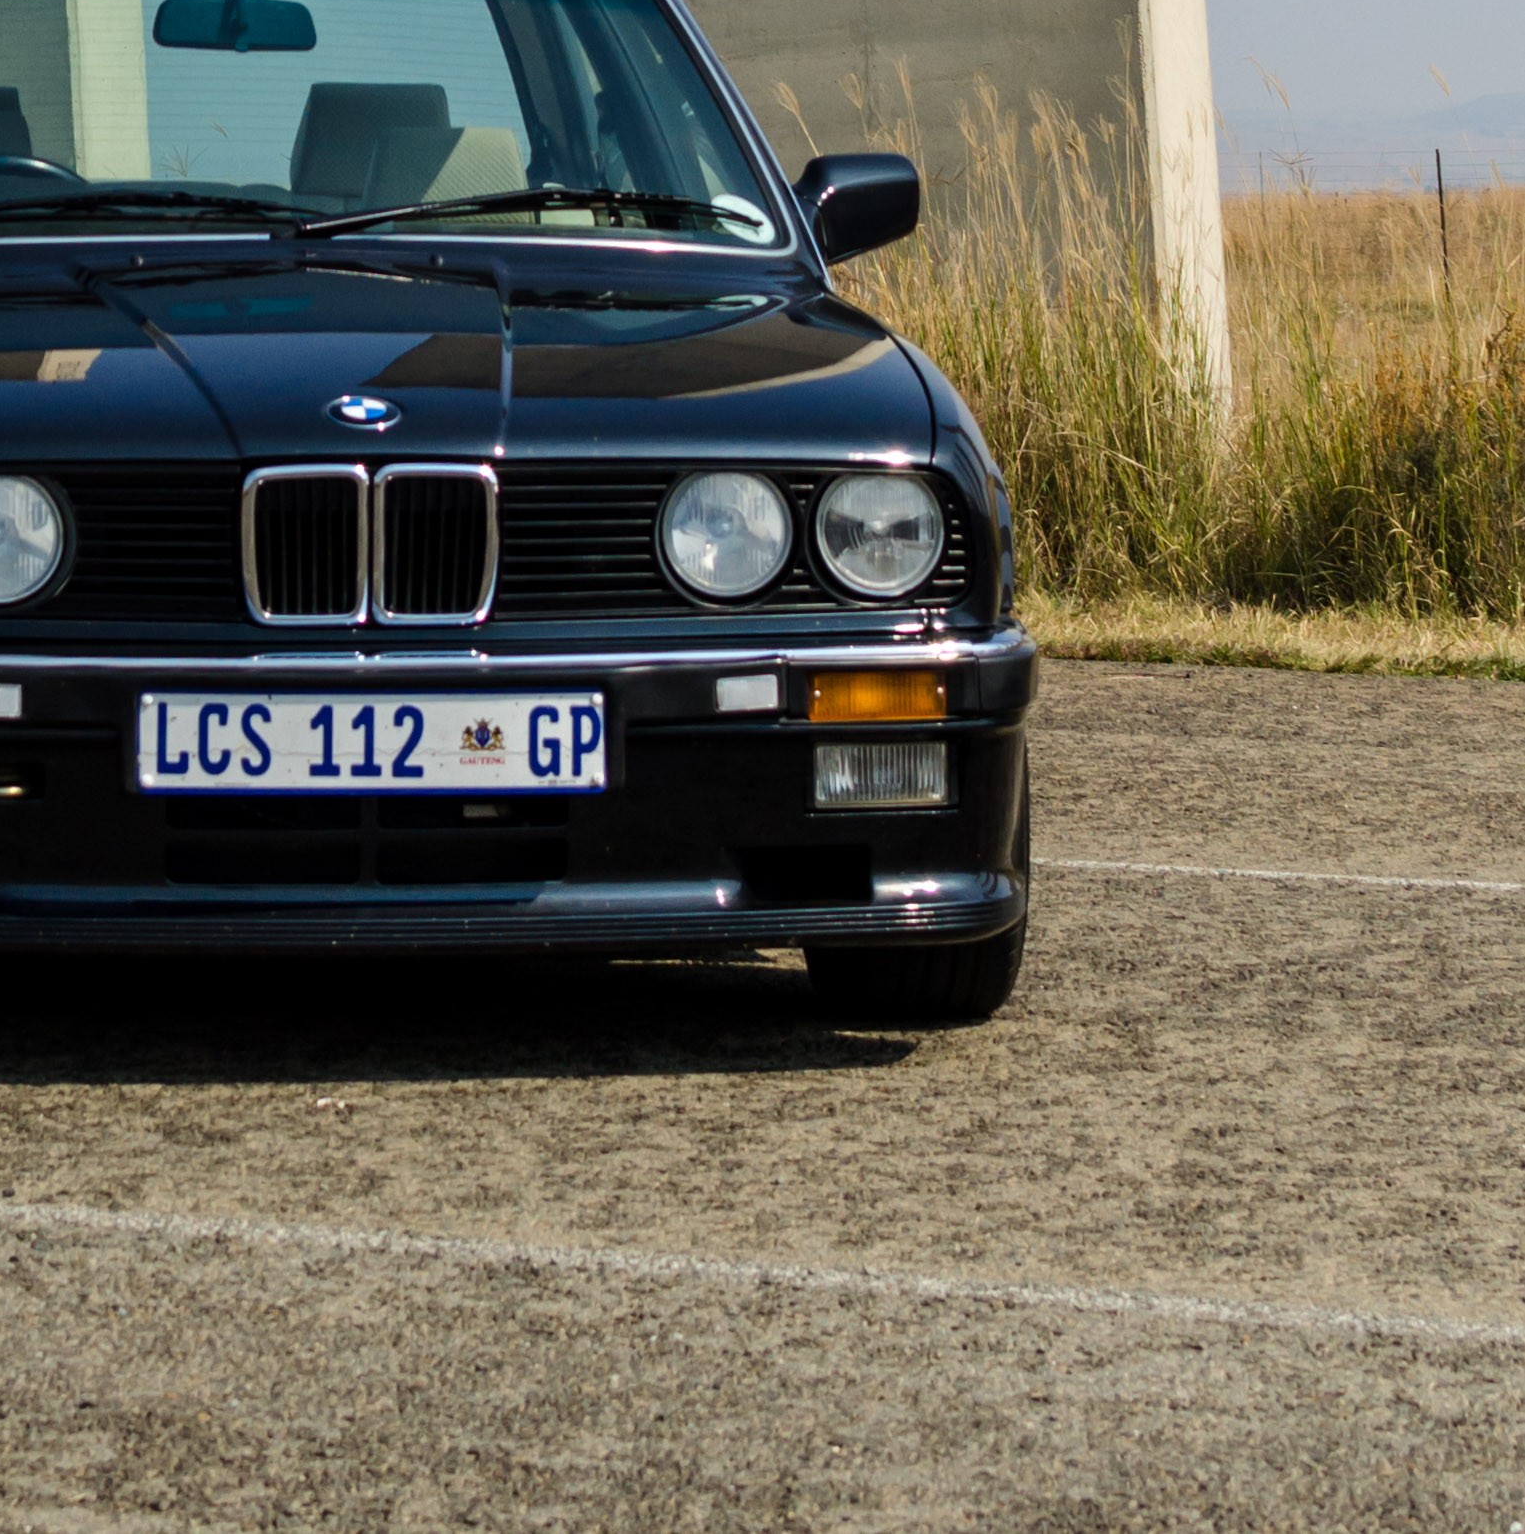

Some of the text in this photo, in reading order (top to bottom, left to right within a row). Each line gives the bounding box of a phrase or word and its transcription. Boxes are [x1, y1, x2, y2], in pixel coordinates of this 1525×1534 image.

[156, 702, 601, 778] LCS 112 GP
[459, 756, 506, 766] GAUTENG
